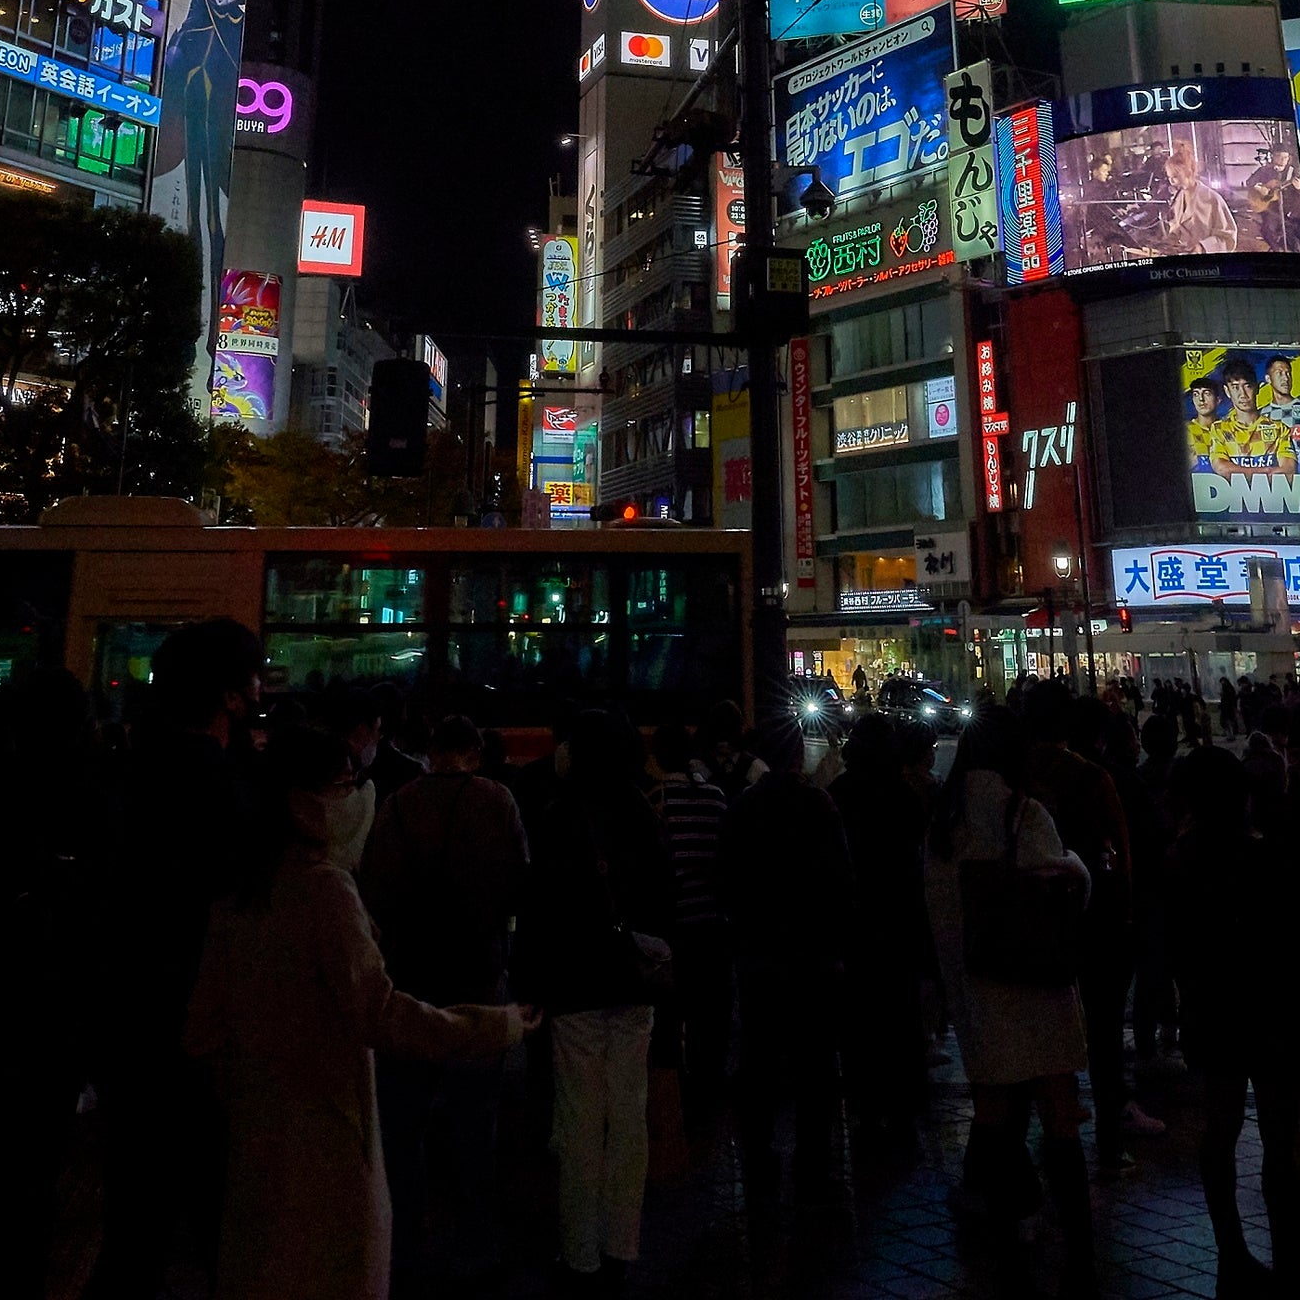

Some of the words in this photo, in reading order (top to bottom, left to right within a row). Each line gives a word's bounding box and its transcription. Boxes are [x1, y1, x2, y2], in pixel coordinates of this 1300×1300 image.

[629, 56, 663, 66] mastercard
[792, 30, 909, 89] #プロジェクトワールドチャンピオン
[40, 60, 158, 116] 英会話イーオン
[236, 79, 293, 133] 09
[786, 60, 885, 143] 日本サッカーに
[1127, 85, 1203, 115] DHC
[237, 119, 265, 133] BUYA
[839, 106, 949, 194] エゴだ。
[950, 72, 998, 249] もんじゃ
[1012, 116, 1040, 270] 三千里薬品
[310, 225, 347, 250] H&M
[832, 236, 882, 276] 西村
[546, 273, 569, 291] W
[1150, 269, 1175, 280] DHC
[1176, 266, 1220, 277] Channel
[980, 345, 994, 411] お好み焼
[986, 442, 1000, 510] もんじゃ焼
[1241, 455, 1274, 469] にしたん
[550, 483, 573, 505] 薬
